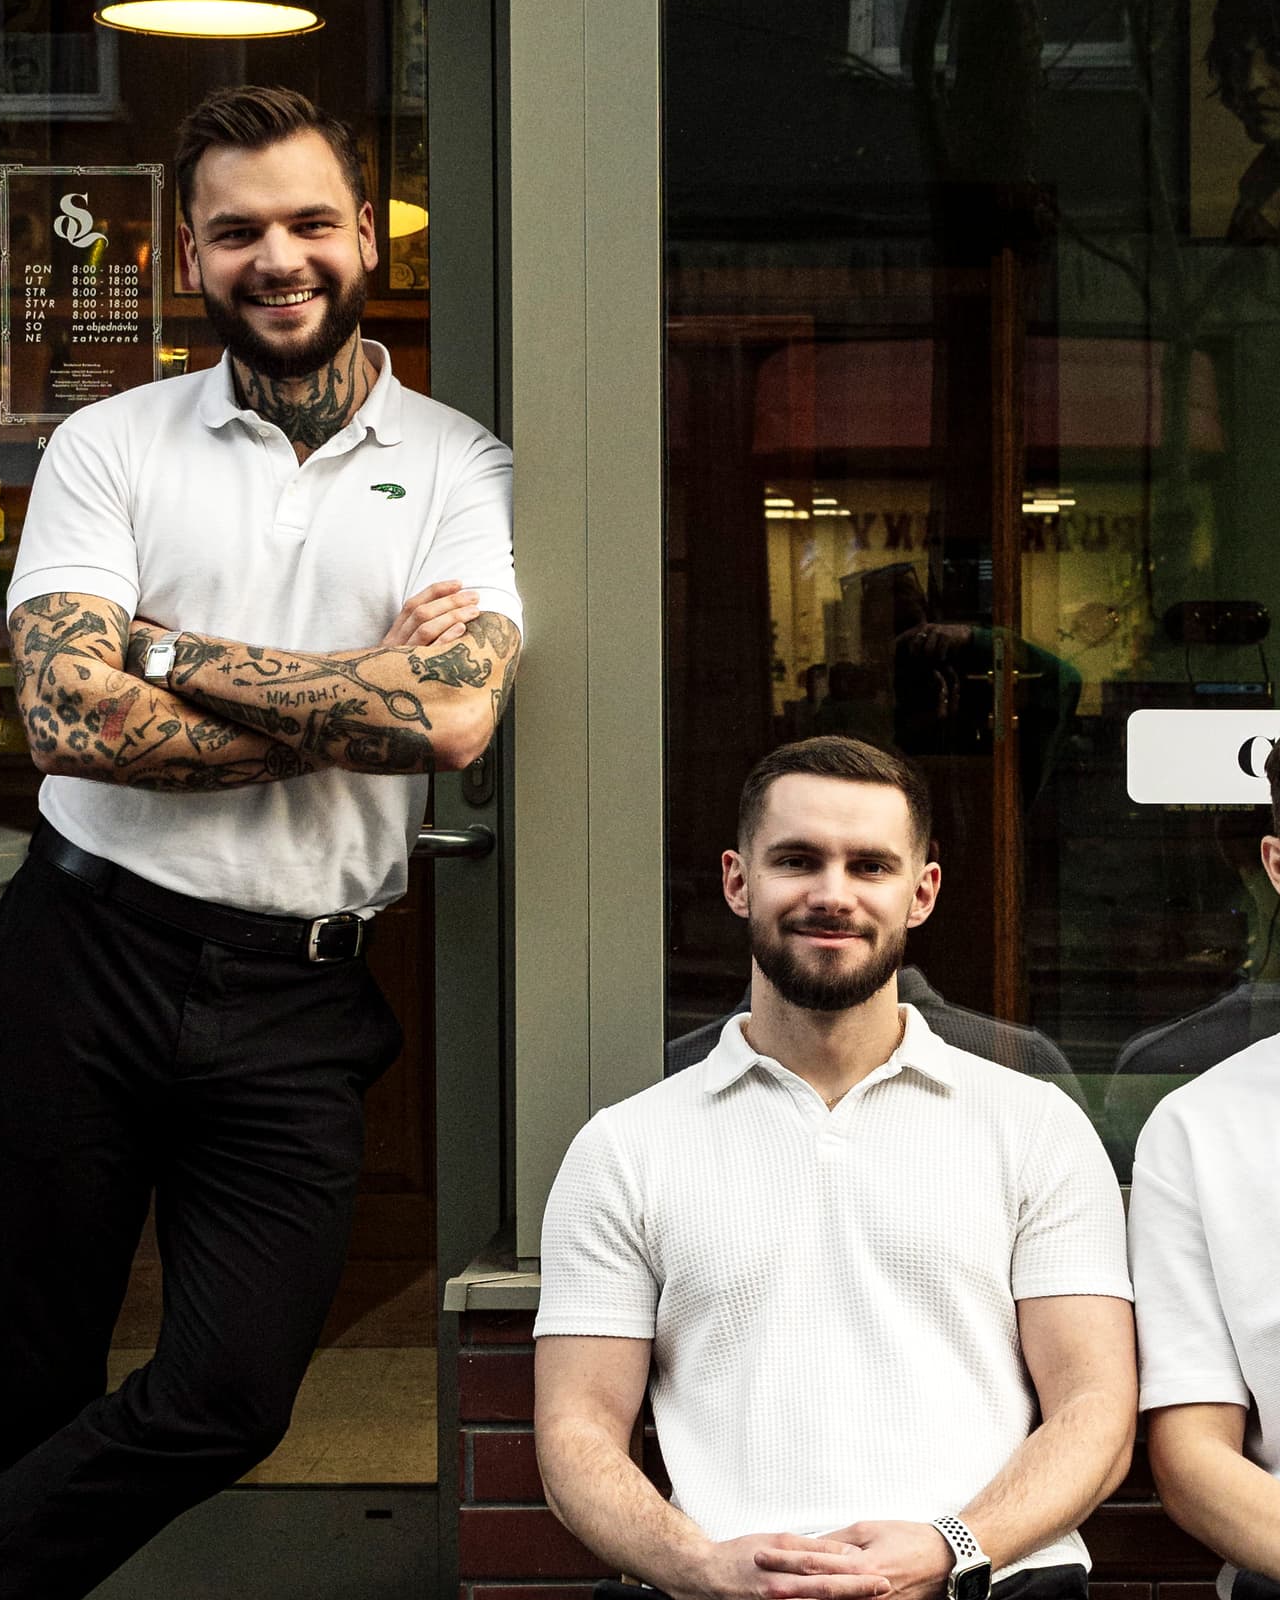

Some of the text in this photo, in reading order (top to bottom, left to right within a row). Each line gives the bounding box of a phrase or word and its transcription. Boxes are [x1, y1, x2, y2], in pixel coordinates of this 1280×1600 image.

[24, 264, 52, 274] PON
[72, 264, 97, 274] 8:00
[108, 264, 139, 274] 18:00
[72, 276, 97, 286] 8:00
[108, 276, 139, 286] 18:00
[25, 287, 46, 297] STR
[72, 287, 97, 297] 8:00
[108, 287, 139, 297] 18:00
[25, 298, 56, 309] ŠTVR
[72, 299, 97, 309] 8:00
[108, 299, 139, 309] 18:00
[25, 310, 46, 320] PIA
[72, 310, 97, 320] 8:00
[108, 310, 139, 320] 18:00
[25, 321, 138, 334] SO na objednávku
[25, 333, 139, 343] NE zatvorené
